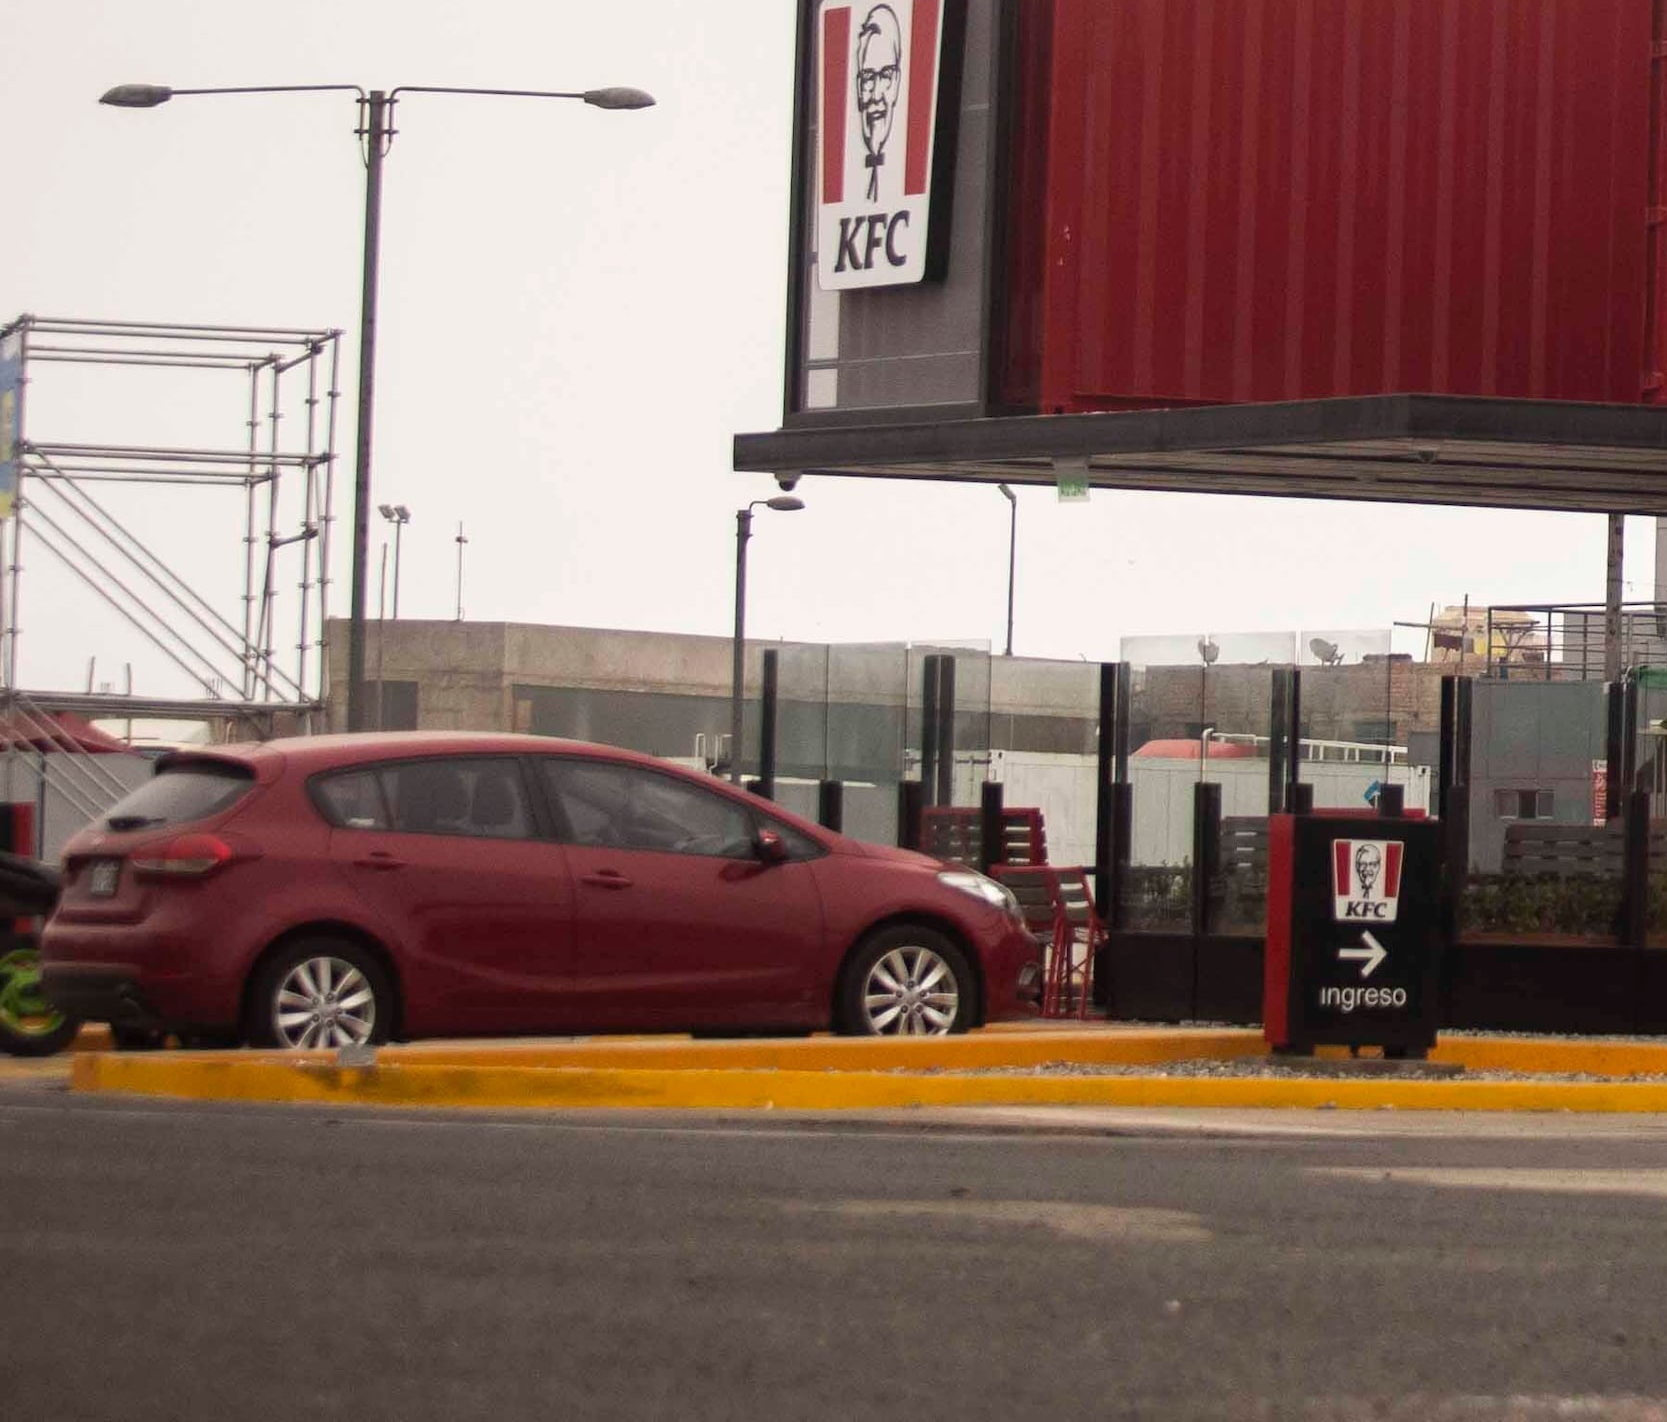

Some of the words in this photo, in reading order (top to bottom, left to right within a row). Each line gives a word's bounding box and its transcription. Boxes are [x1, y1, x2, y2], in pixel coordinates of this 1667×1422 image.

[834, 210, 910, 273] KFC
[1345, 901, 1388, 918] KFC
[1319, 986, 1408, 1012] ingreso
